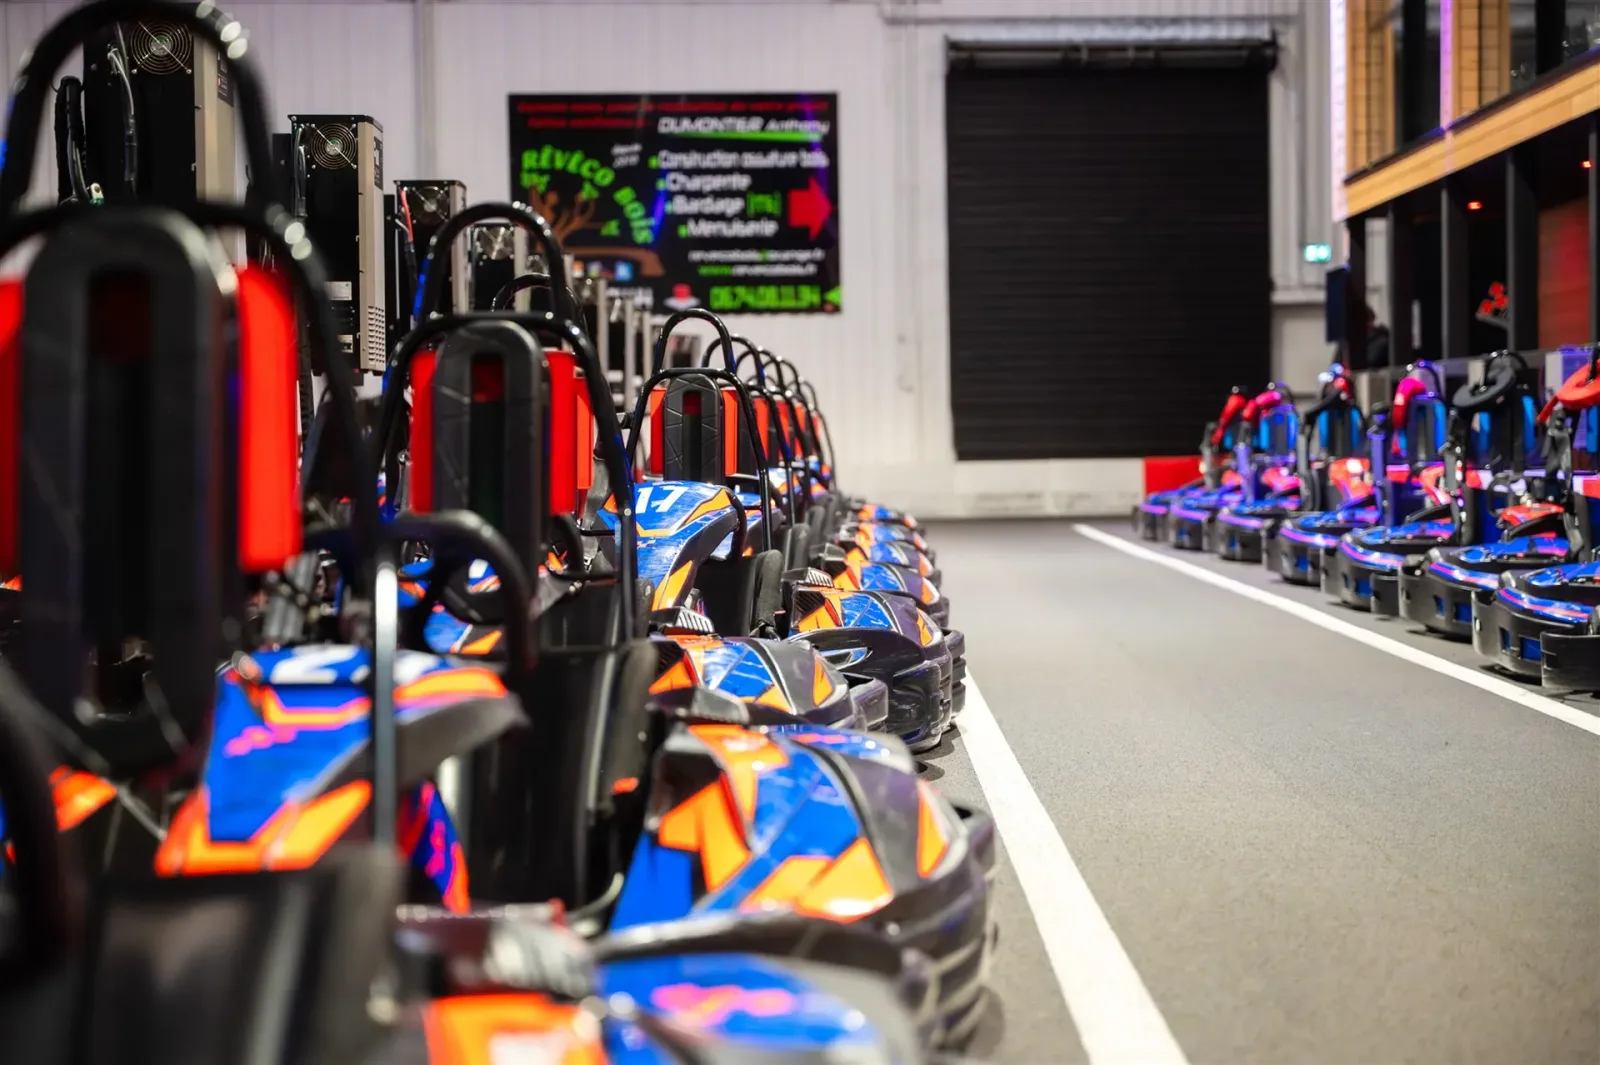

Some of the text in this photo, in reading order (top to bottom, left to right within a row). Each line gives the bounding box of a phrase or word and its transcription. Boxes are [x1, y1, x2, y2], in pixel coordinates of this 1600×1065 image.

[666, 173, 751, 193] Charpente
[687, 218, 778, 238] Menuiserie
[635, 485, 690, 514] 17
